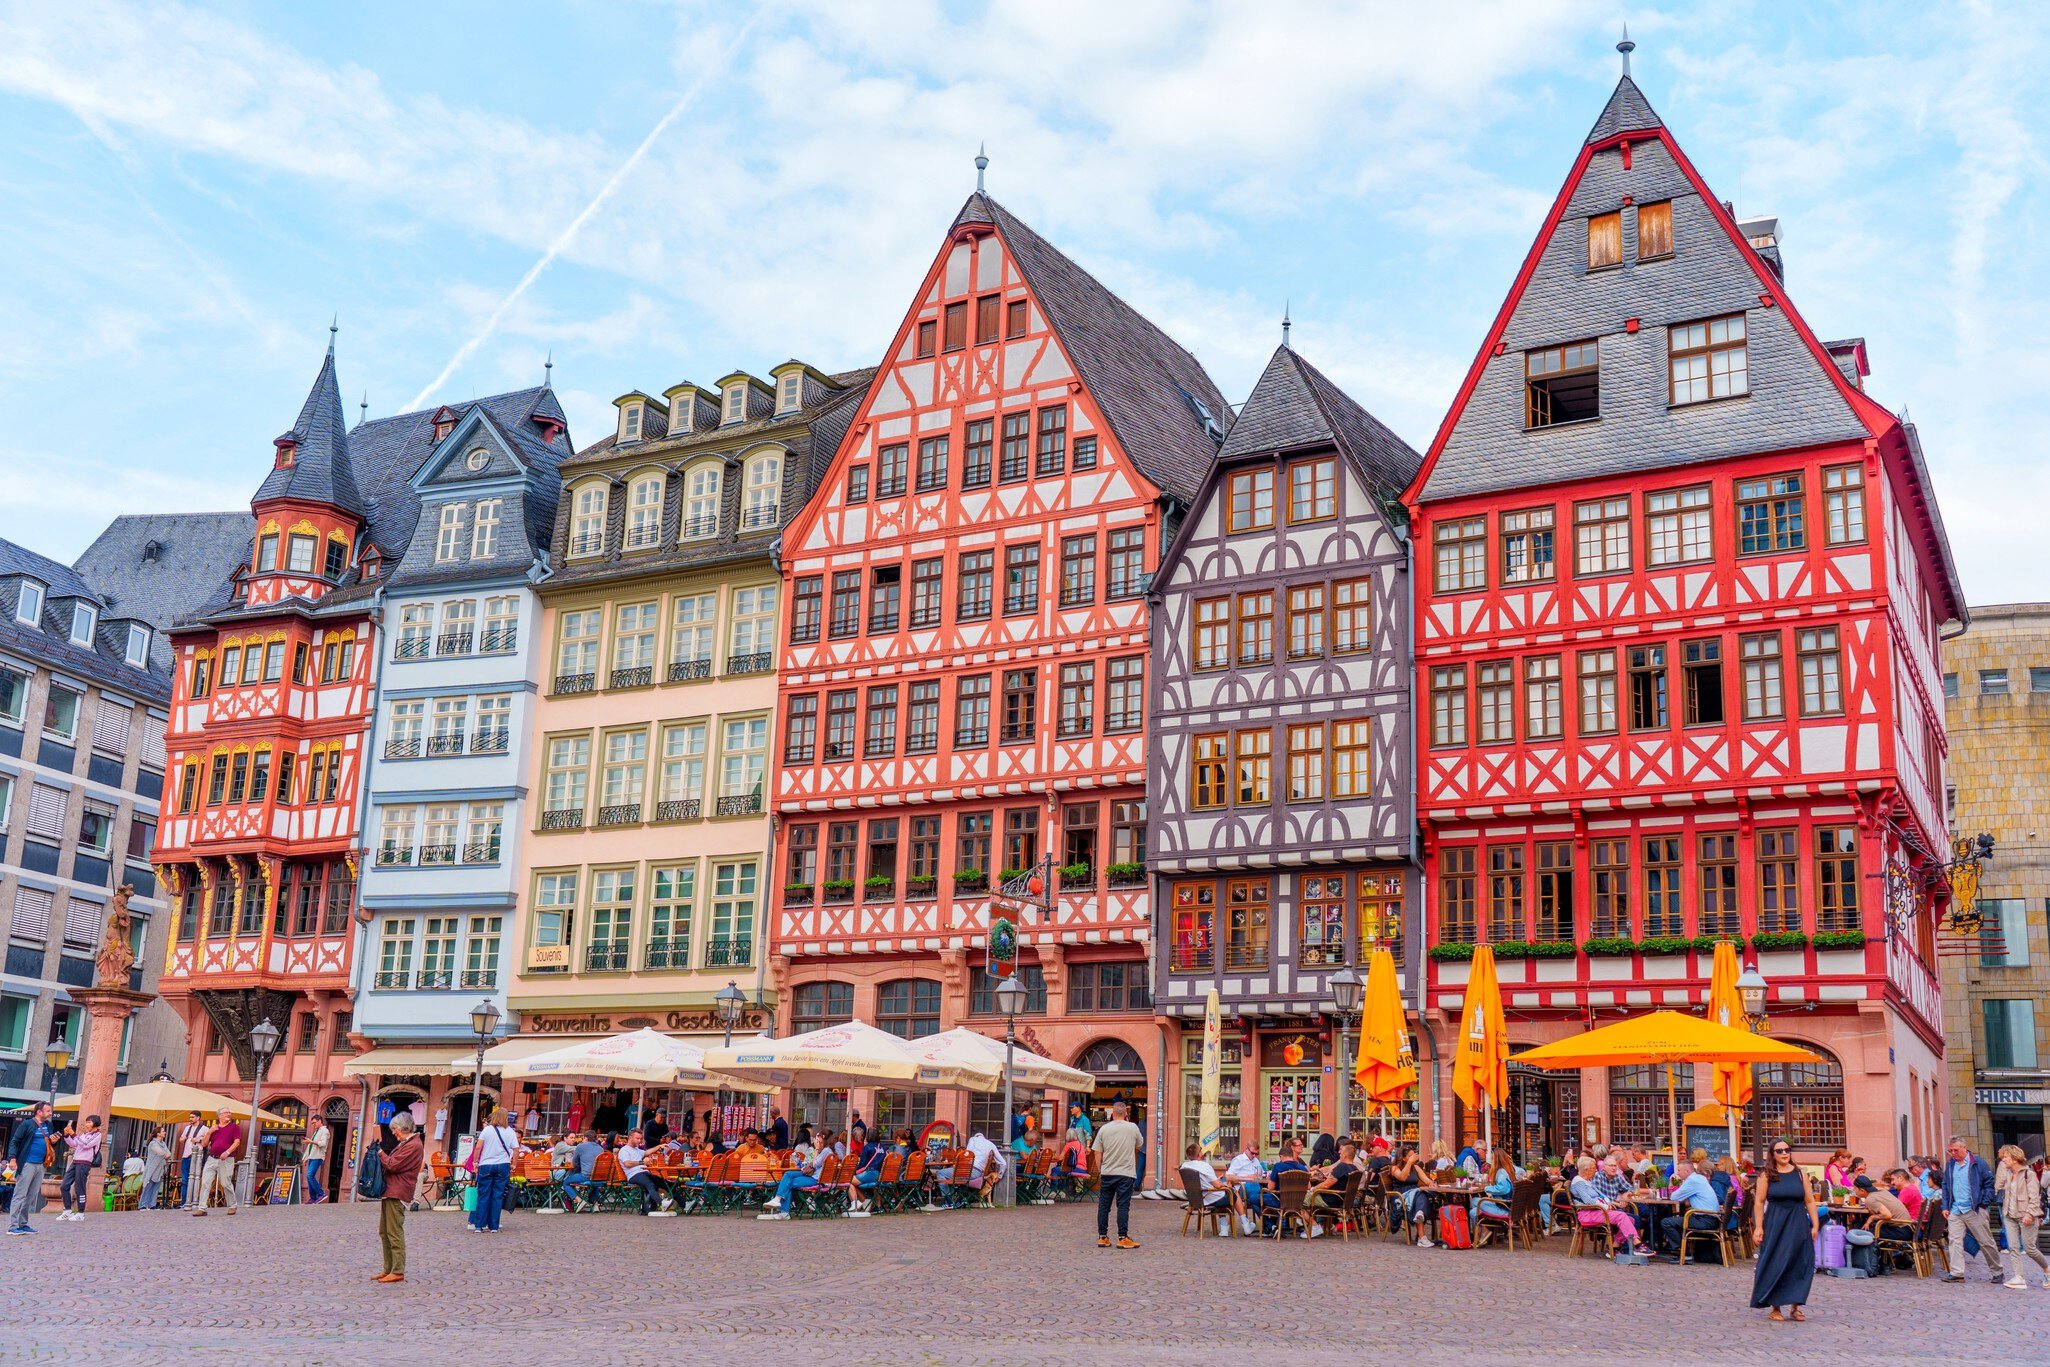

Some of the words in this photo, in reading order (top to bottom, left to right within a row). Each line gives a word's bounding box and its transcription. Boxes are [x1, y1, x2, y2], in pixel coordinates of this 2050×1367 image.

[536, 949, 562, 963] Souvenirs
[532, 1014, 611, 1032] Souvenirs
[1288, 1019, 1304, 1027] 1881
[830, 1058, 845, 1066] Apfel
